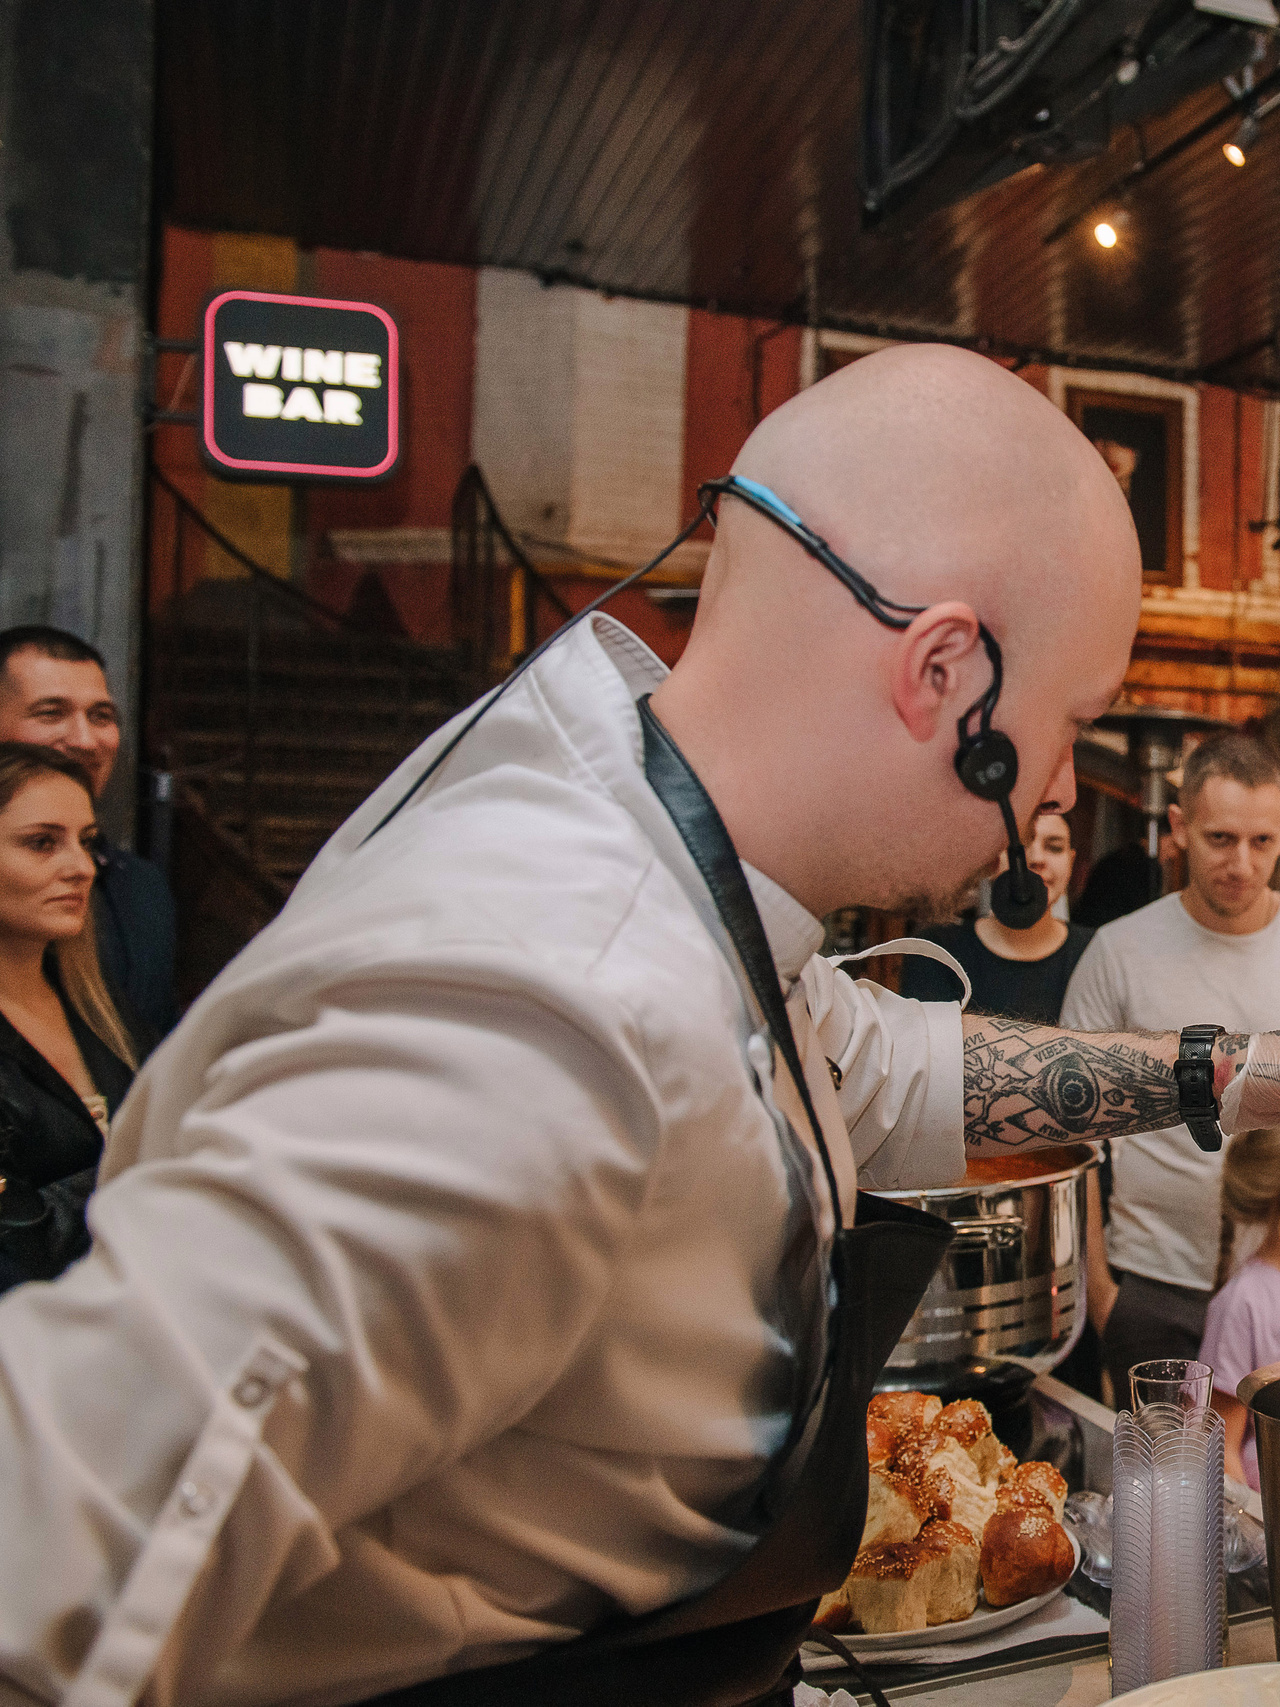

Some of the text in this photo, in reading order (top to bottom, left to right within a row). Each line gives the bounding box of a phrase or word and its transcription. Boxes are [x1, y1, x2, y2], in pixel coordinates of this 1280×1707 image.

[223, 341, 382, 389] WINE
[242, 382, 364, 426] BAR
[1033, 1040, 1068, 1063] VIBES
